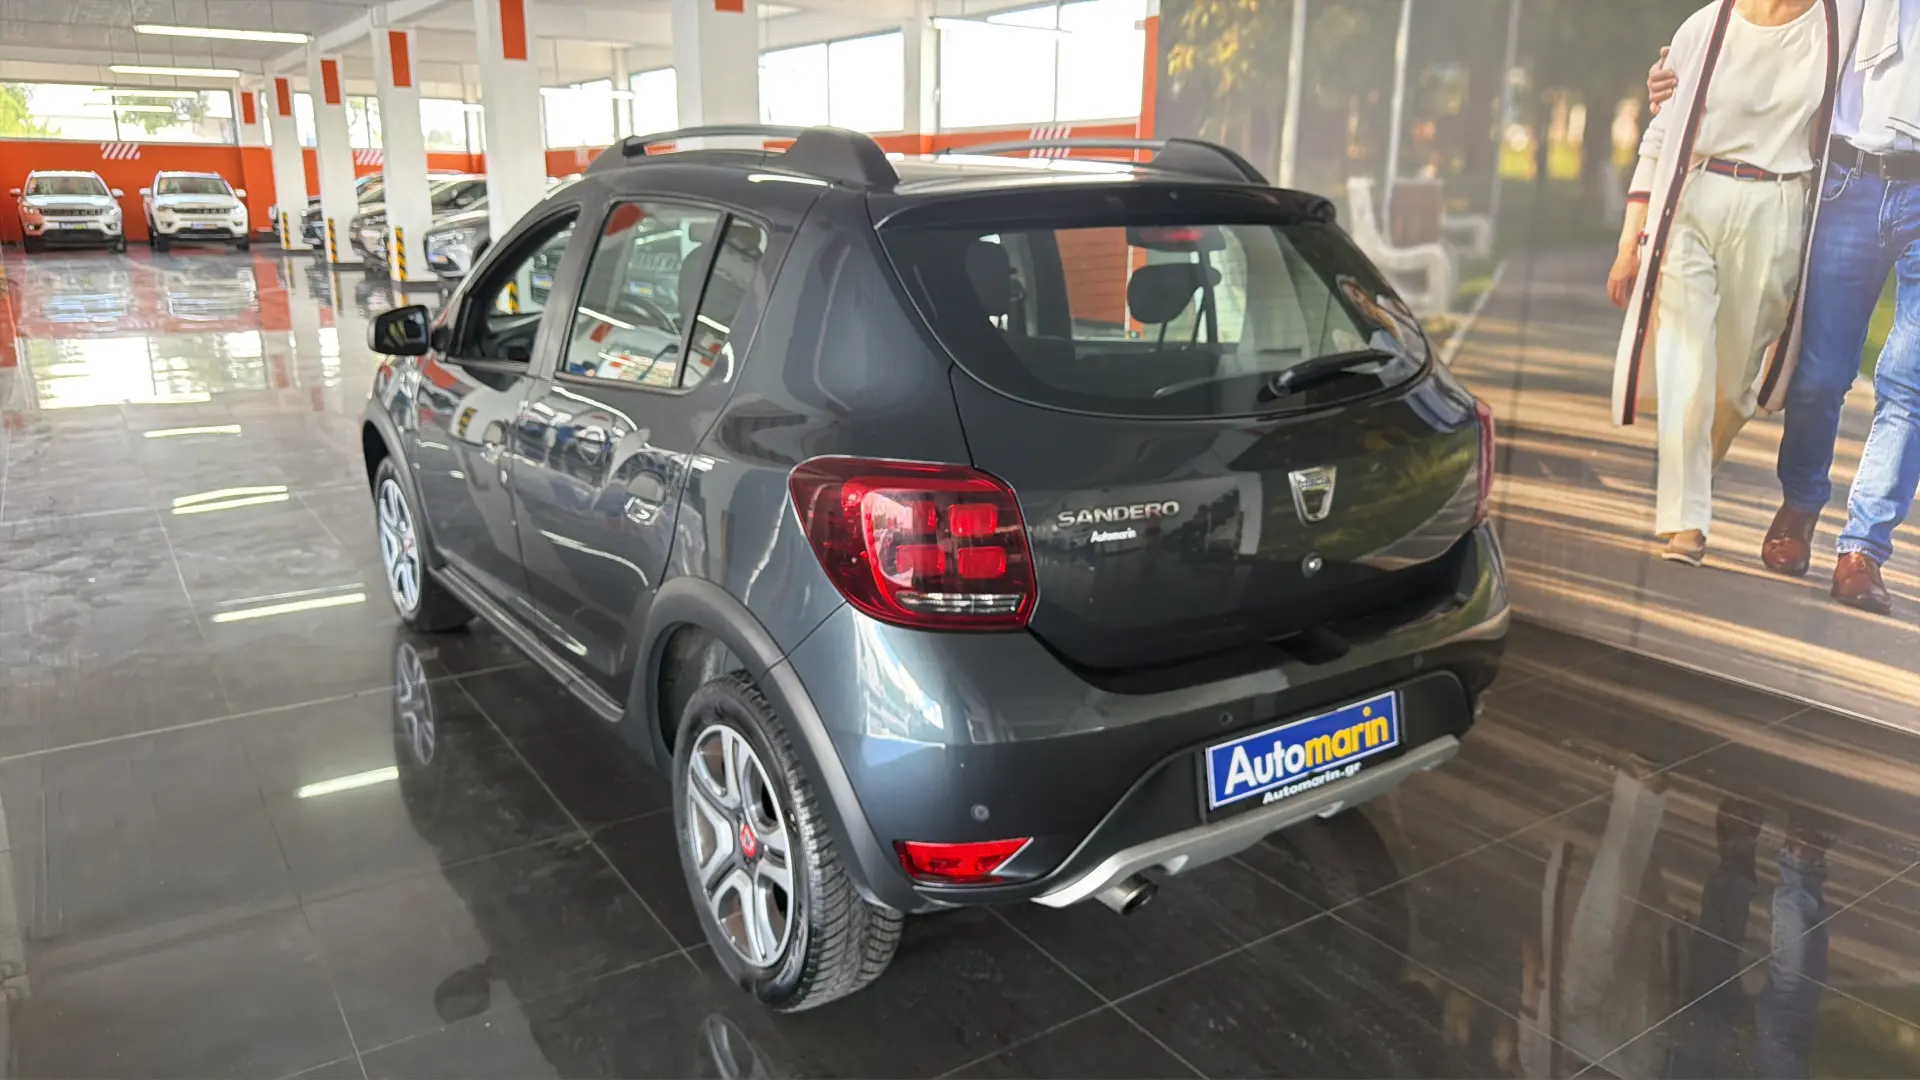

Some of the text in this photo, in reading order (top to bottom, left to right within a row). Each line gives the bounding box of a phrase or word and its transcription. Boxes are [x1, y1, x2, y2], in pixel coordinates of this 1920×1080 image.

[1057, 501, 1180, 527] SANDERO
[1090, 527, 1137, 543] Automarin
[1224, 706, 1389, 795] Automarin
[1262, 762, 1363, 804] Automarin.gr
